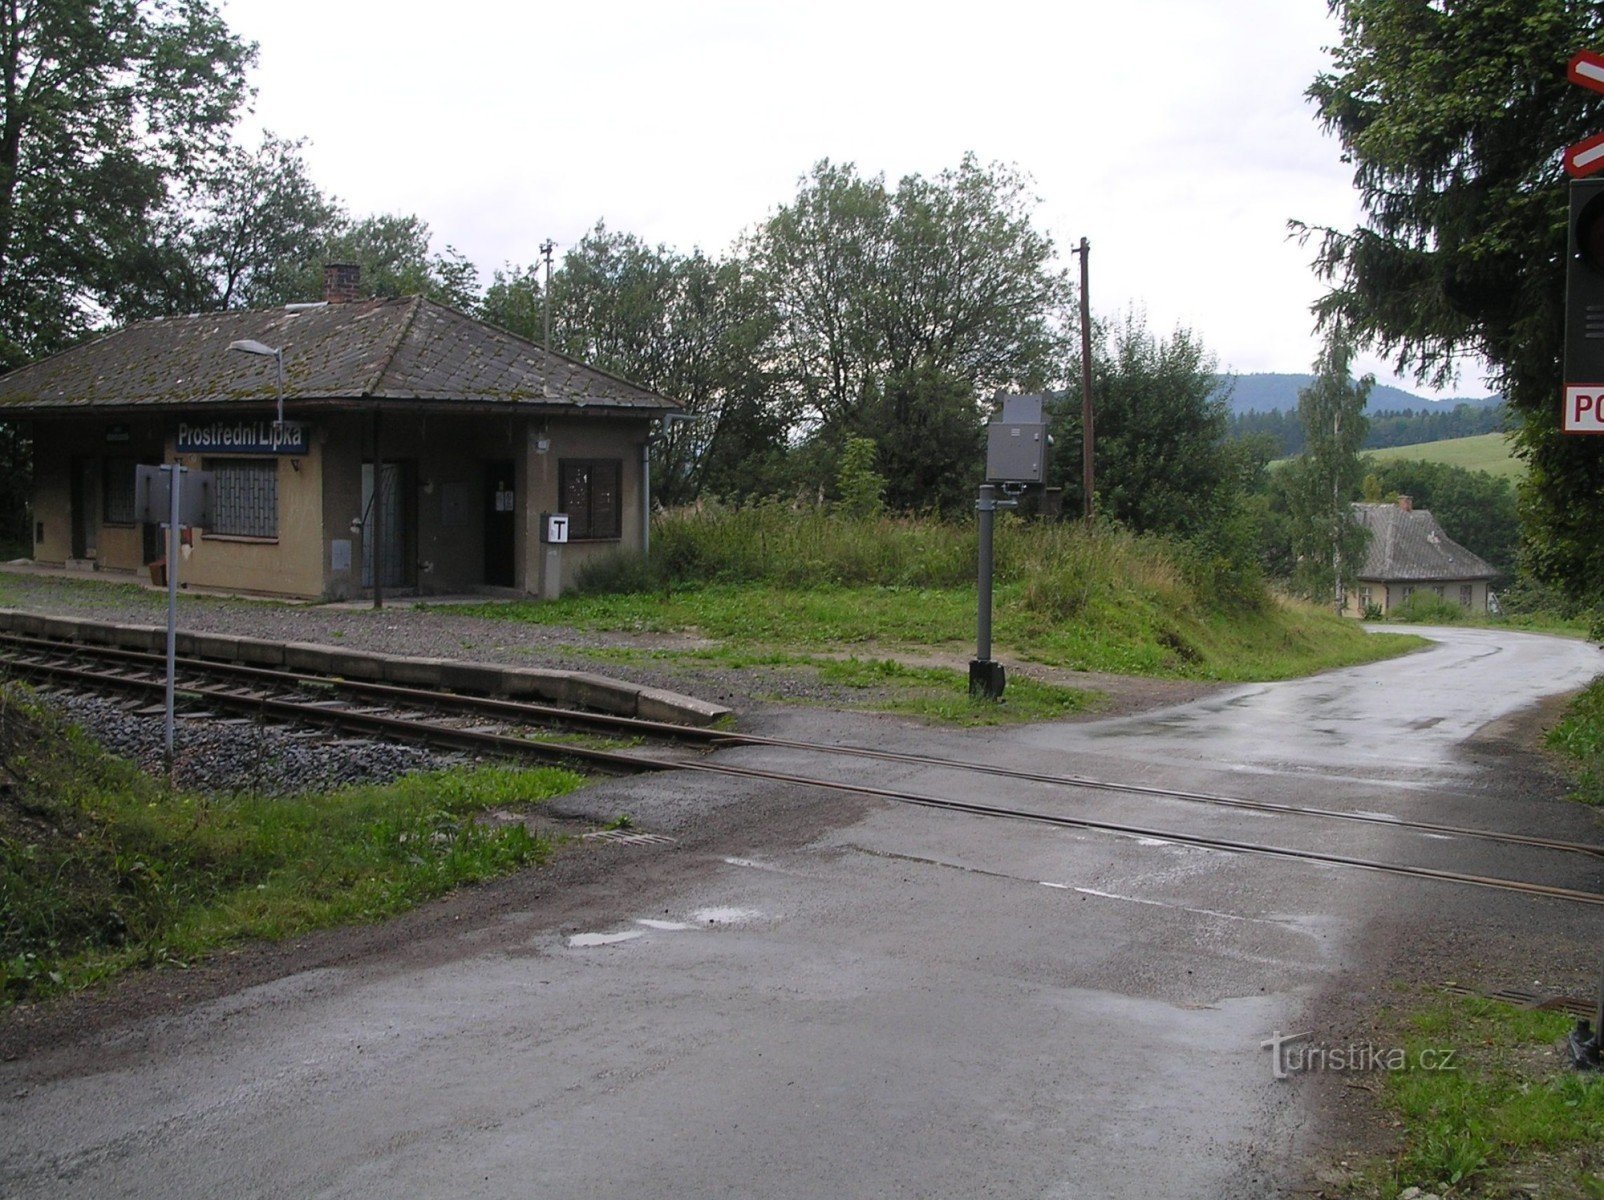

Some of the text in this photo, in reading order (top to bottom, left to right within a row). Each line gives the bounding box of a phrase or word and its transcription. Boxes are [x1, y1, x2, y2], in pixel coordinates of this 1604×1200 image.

[178, 421, 302, 451] Prostřední Lipka
[553, 520, 566, 540] T
